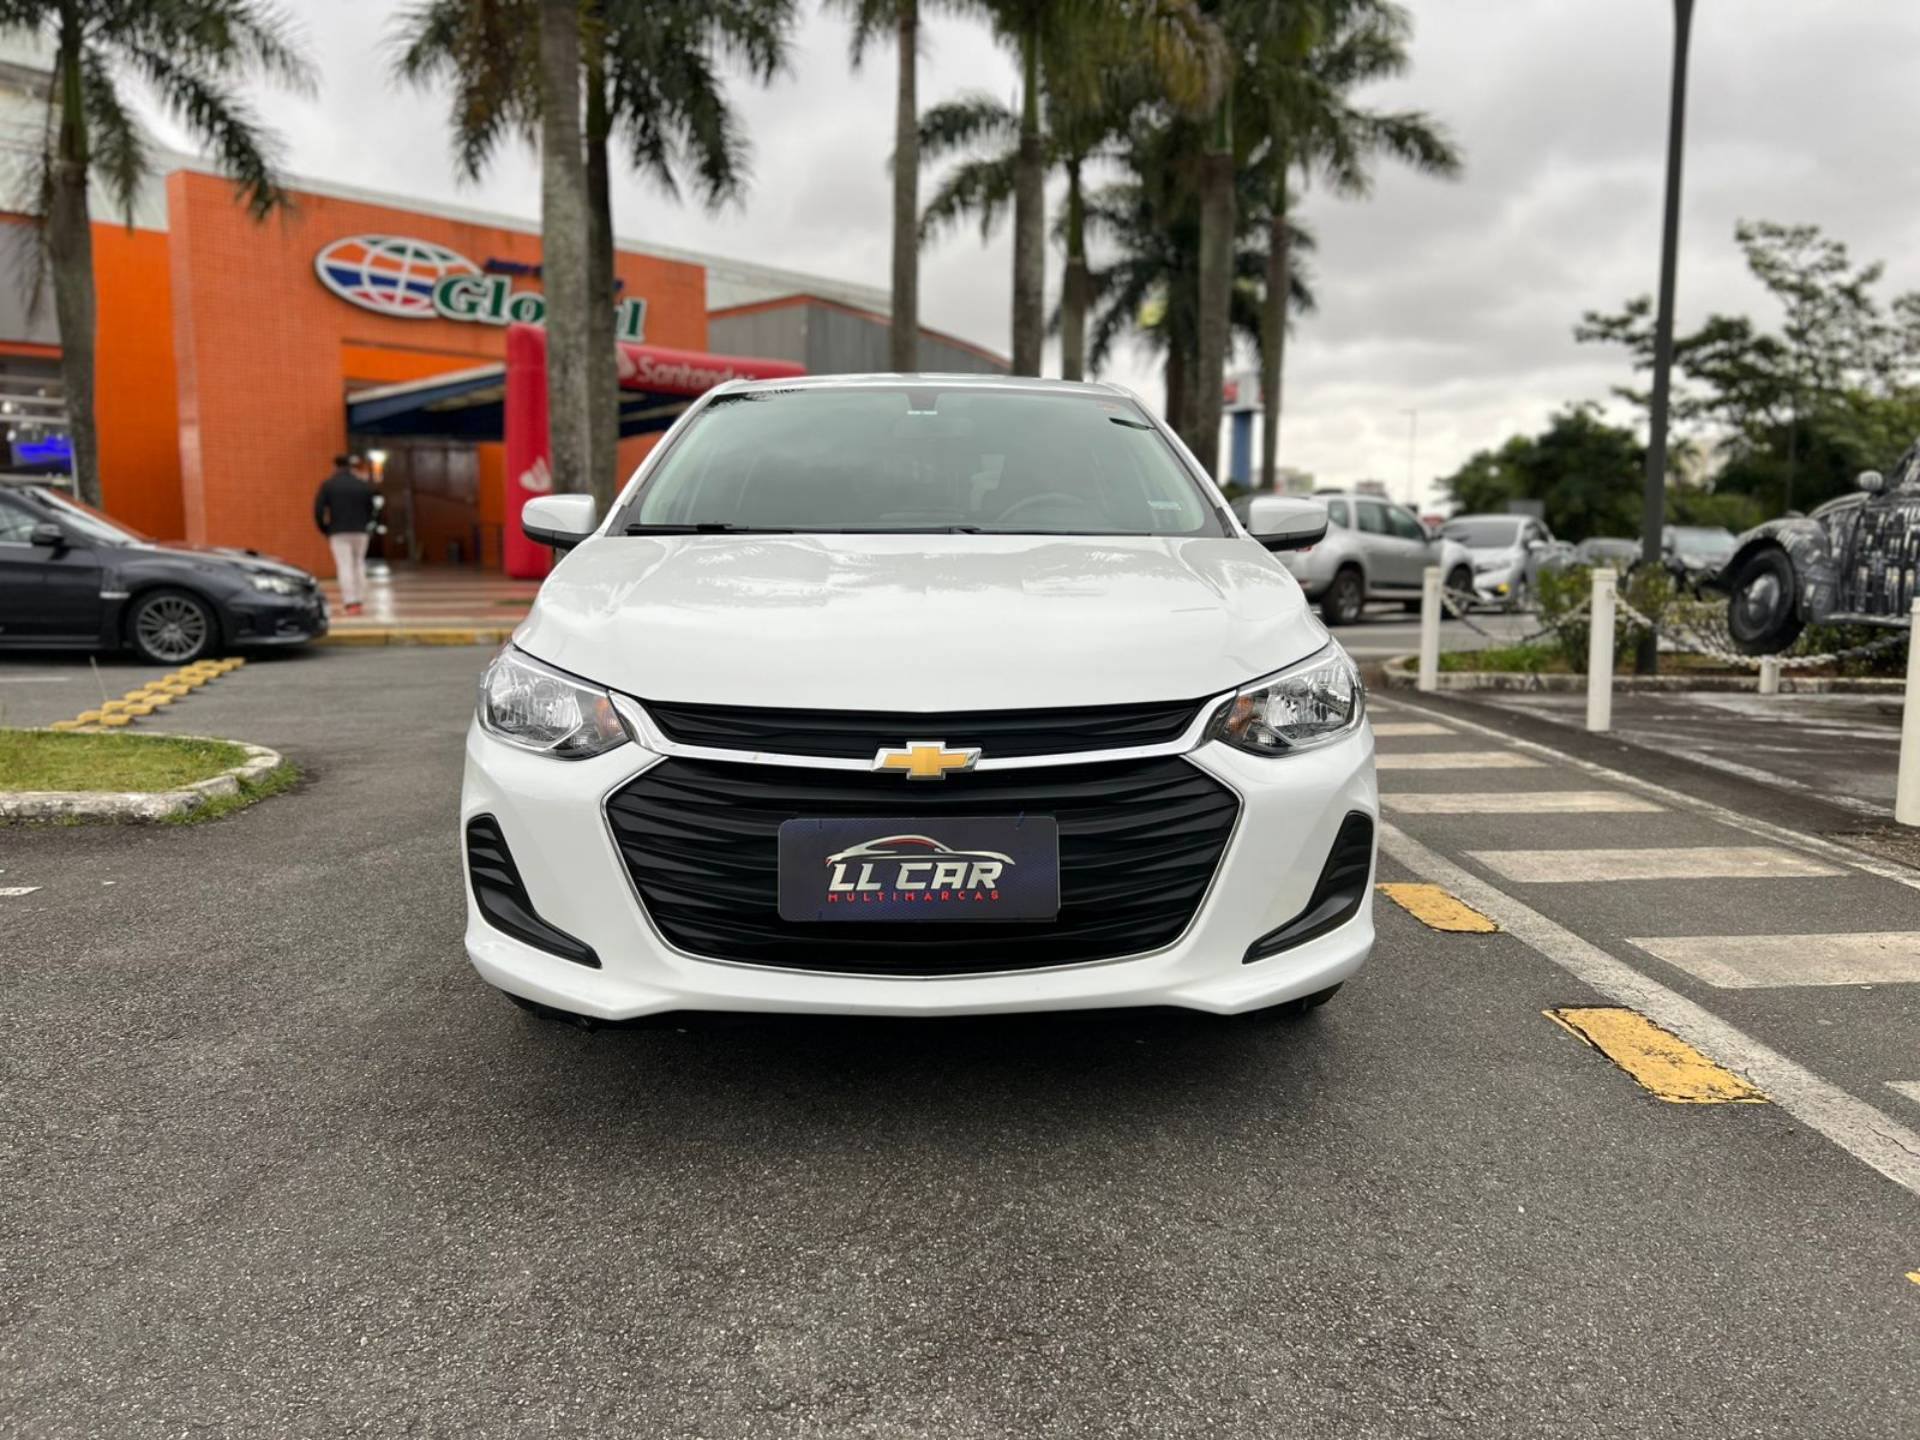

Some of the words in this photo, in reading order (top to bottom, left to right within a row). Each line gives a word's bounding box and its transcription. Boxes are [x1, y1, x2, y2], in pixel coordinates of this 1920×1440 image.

[434, 274, 646, 342] Glol
[829, 863, 881, 891] LL
[895, 862, 1003, 890] CAR
[828, 890, 999, 902] MULTIMARCAS
